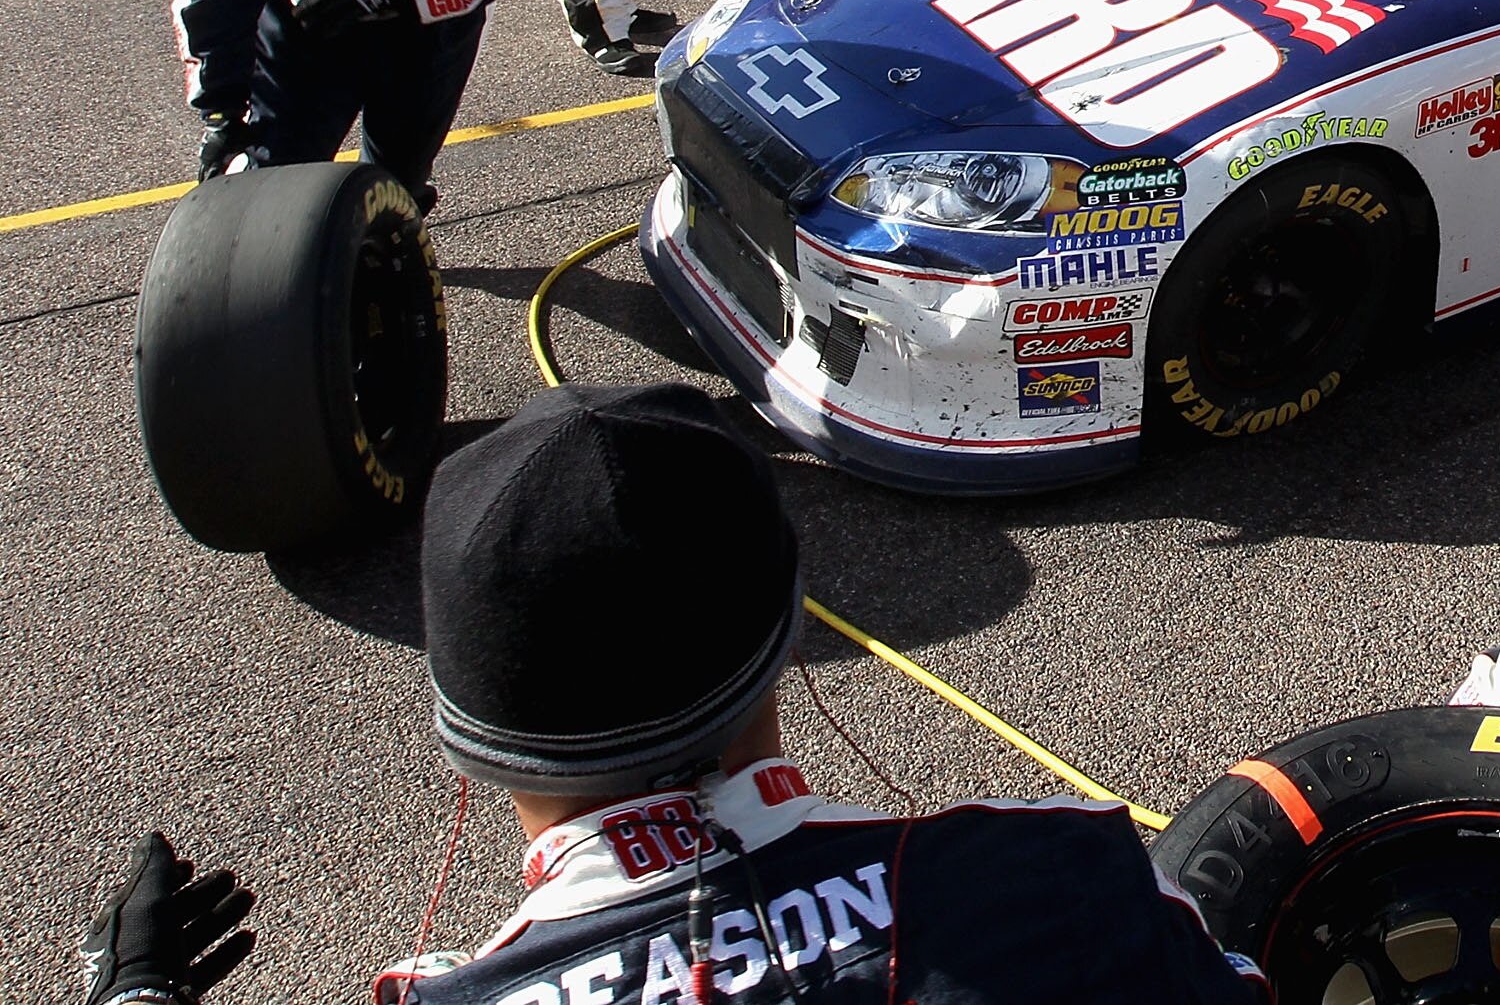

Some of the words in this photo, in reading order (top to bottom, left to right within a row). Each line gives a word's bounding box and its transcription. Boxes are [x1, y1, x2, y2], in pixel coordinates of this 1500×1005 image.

[1419, 85, 1492, 128] Holley
[1418, 123, 1435, 136] HP
[1436, 109, 1478, 129] CARBS
[1227, 110, 1389, 181] GOODYEAR
[1093, 157, 1166, 172] GOODYEAR
[1080, 168, 1180, 193] Gatorback
[1088, 187, 1177, 206] BELTS
[1298, 183, 1389, 225] EAGLE
[1050, 202, 1181, 238] MOOG
[1055, 234, 1120, 252] CHASSIS
[1130, 228, 1177, 244] PARTS
[1020, 247, 1158, 289] MAHLE
[1013, 296, 1118, 325] COMP
[1084, 309, 1132, 323] CAMS
[1018, 331, 1128, 357] Edelbrock
[1026, 378, 1094, 395] SUNOCO
[1164, 355, 1342, 437] GOODYEAR
[601, 797, 718, 882] 88
